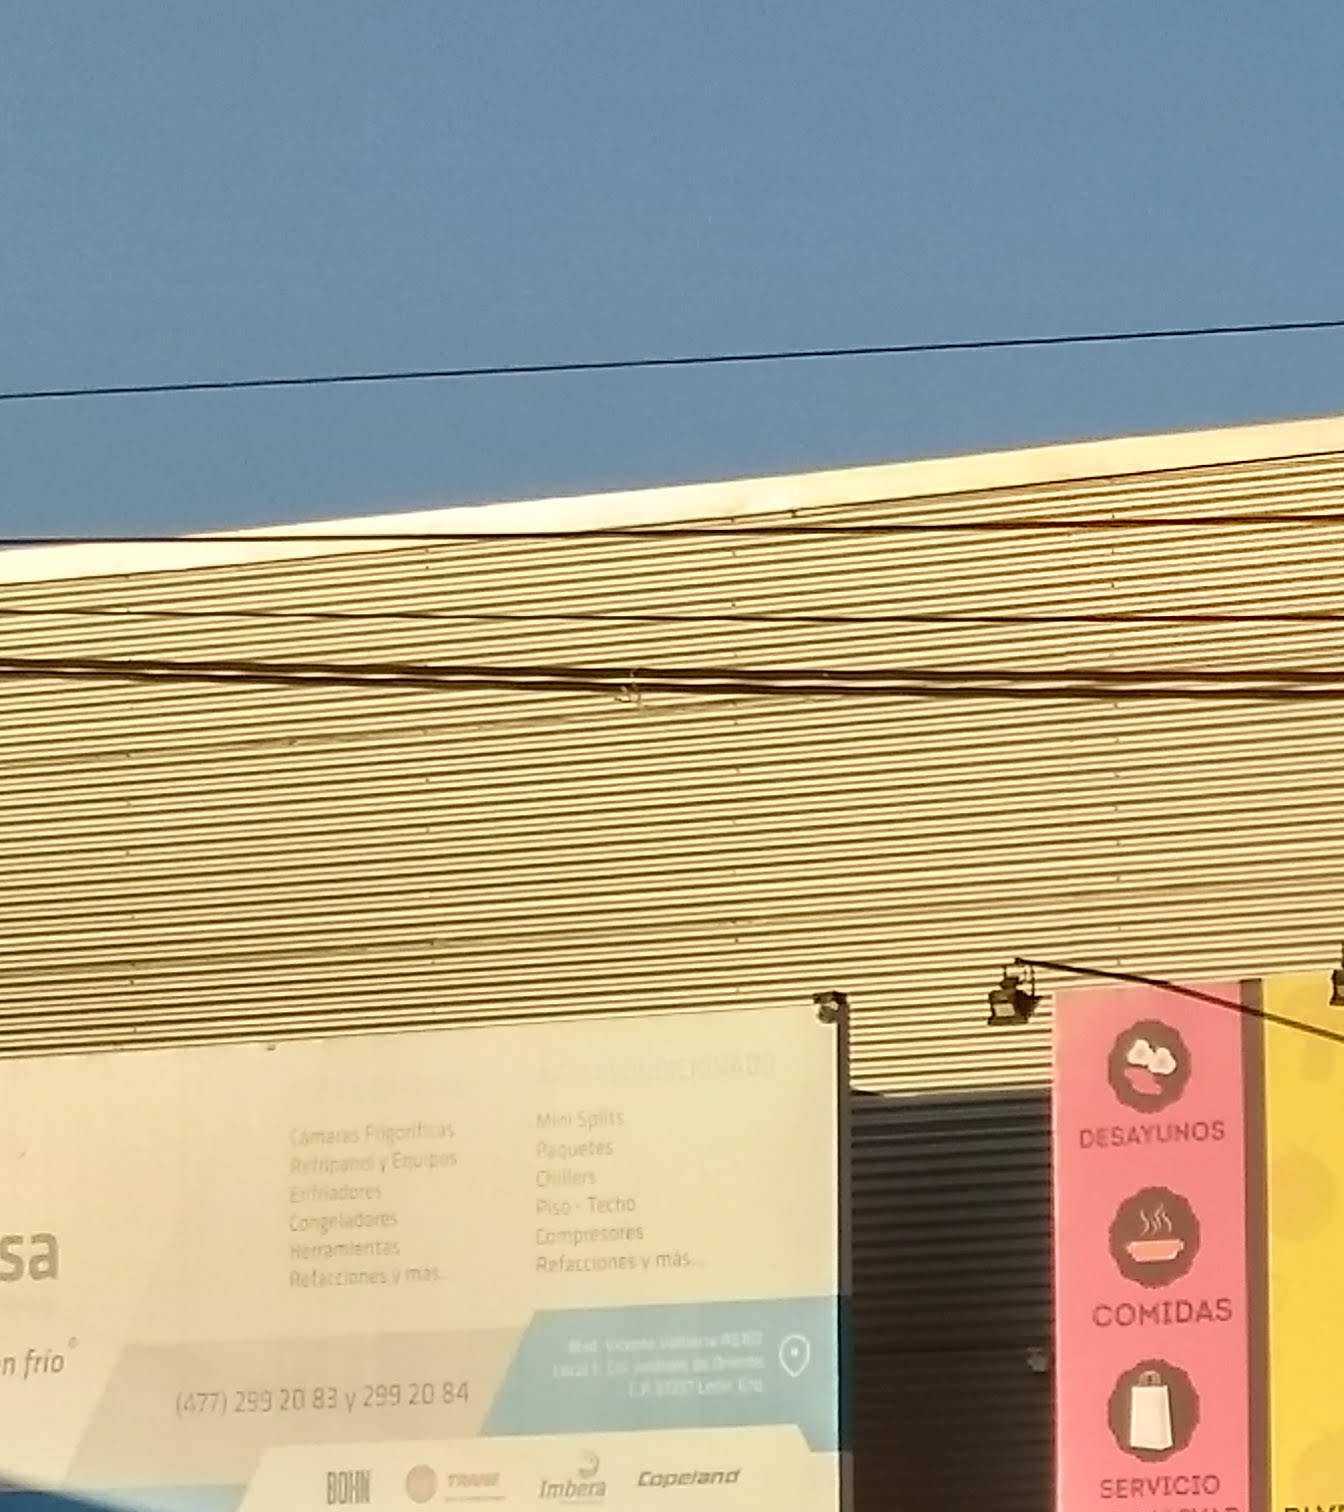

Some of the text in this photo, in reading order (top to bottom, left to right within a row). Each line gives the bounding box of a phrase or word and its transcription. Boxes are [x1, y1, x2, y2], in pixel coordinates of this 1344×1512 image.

[1080, 1120, 1227, 1149] DESAYUNOS
[587, 1194, 637, 1214] Techo
[537, 1226, 645, 1248] Compresores
[537, 1254, 637, 1273] Refacciones
[1092, 1299, 1235, 1327] COMIDAS
[175, 1380, 469, 1418] (477) 299 20 83 y 299 20 84
[326, 1470, 371, 1505] BOHN
[538, 1479, 605, 1500] Imbera
[637, 1467, 742, 1488] Copeland
[1099, 1474, 1221, 1500] SERVICIO
